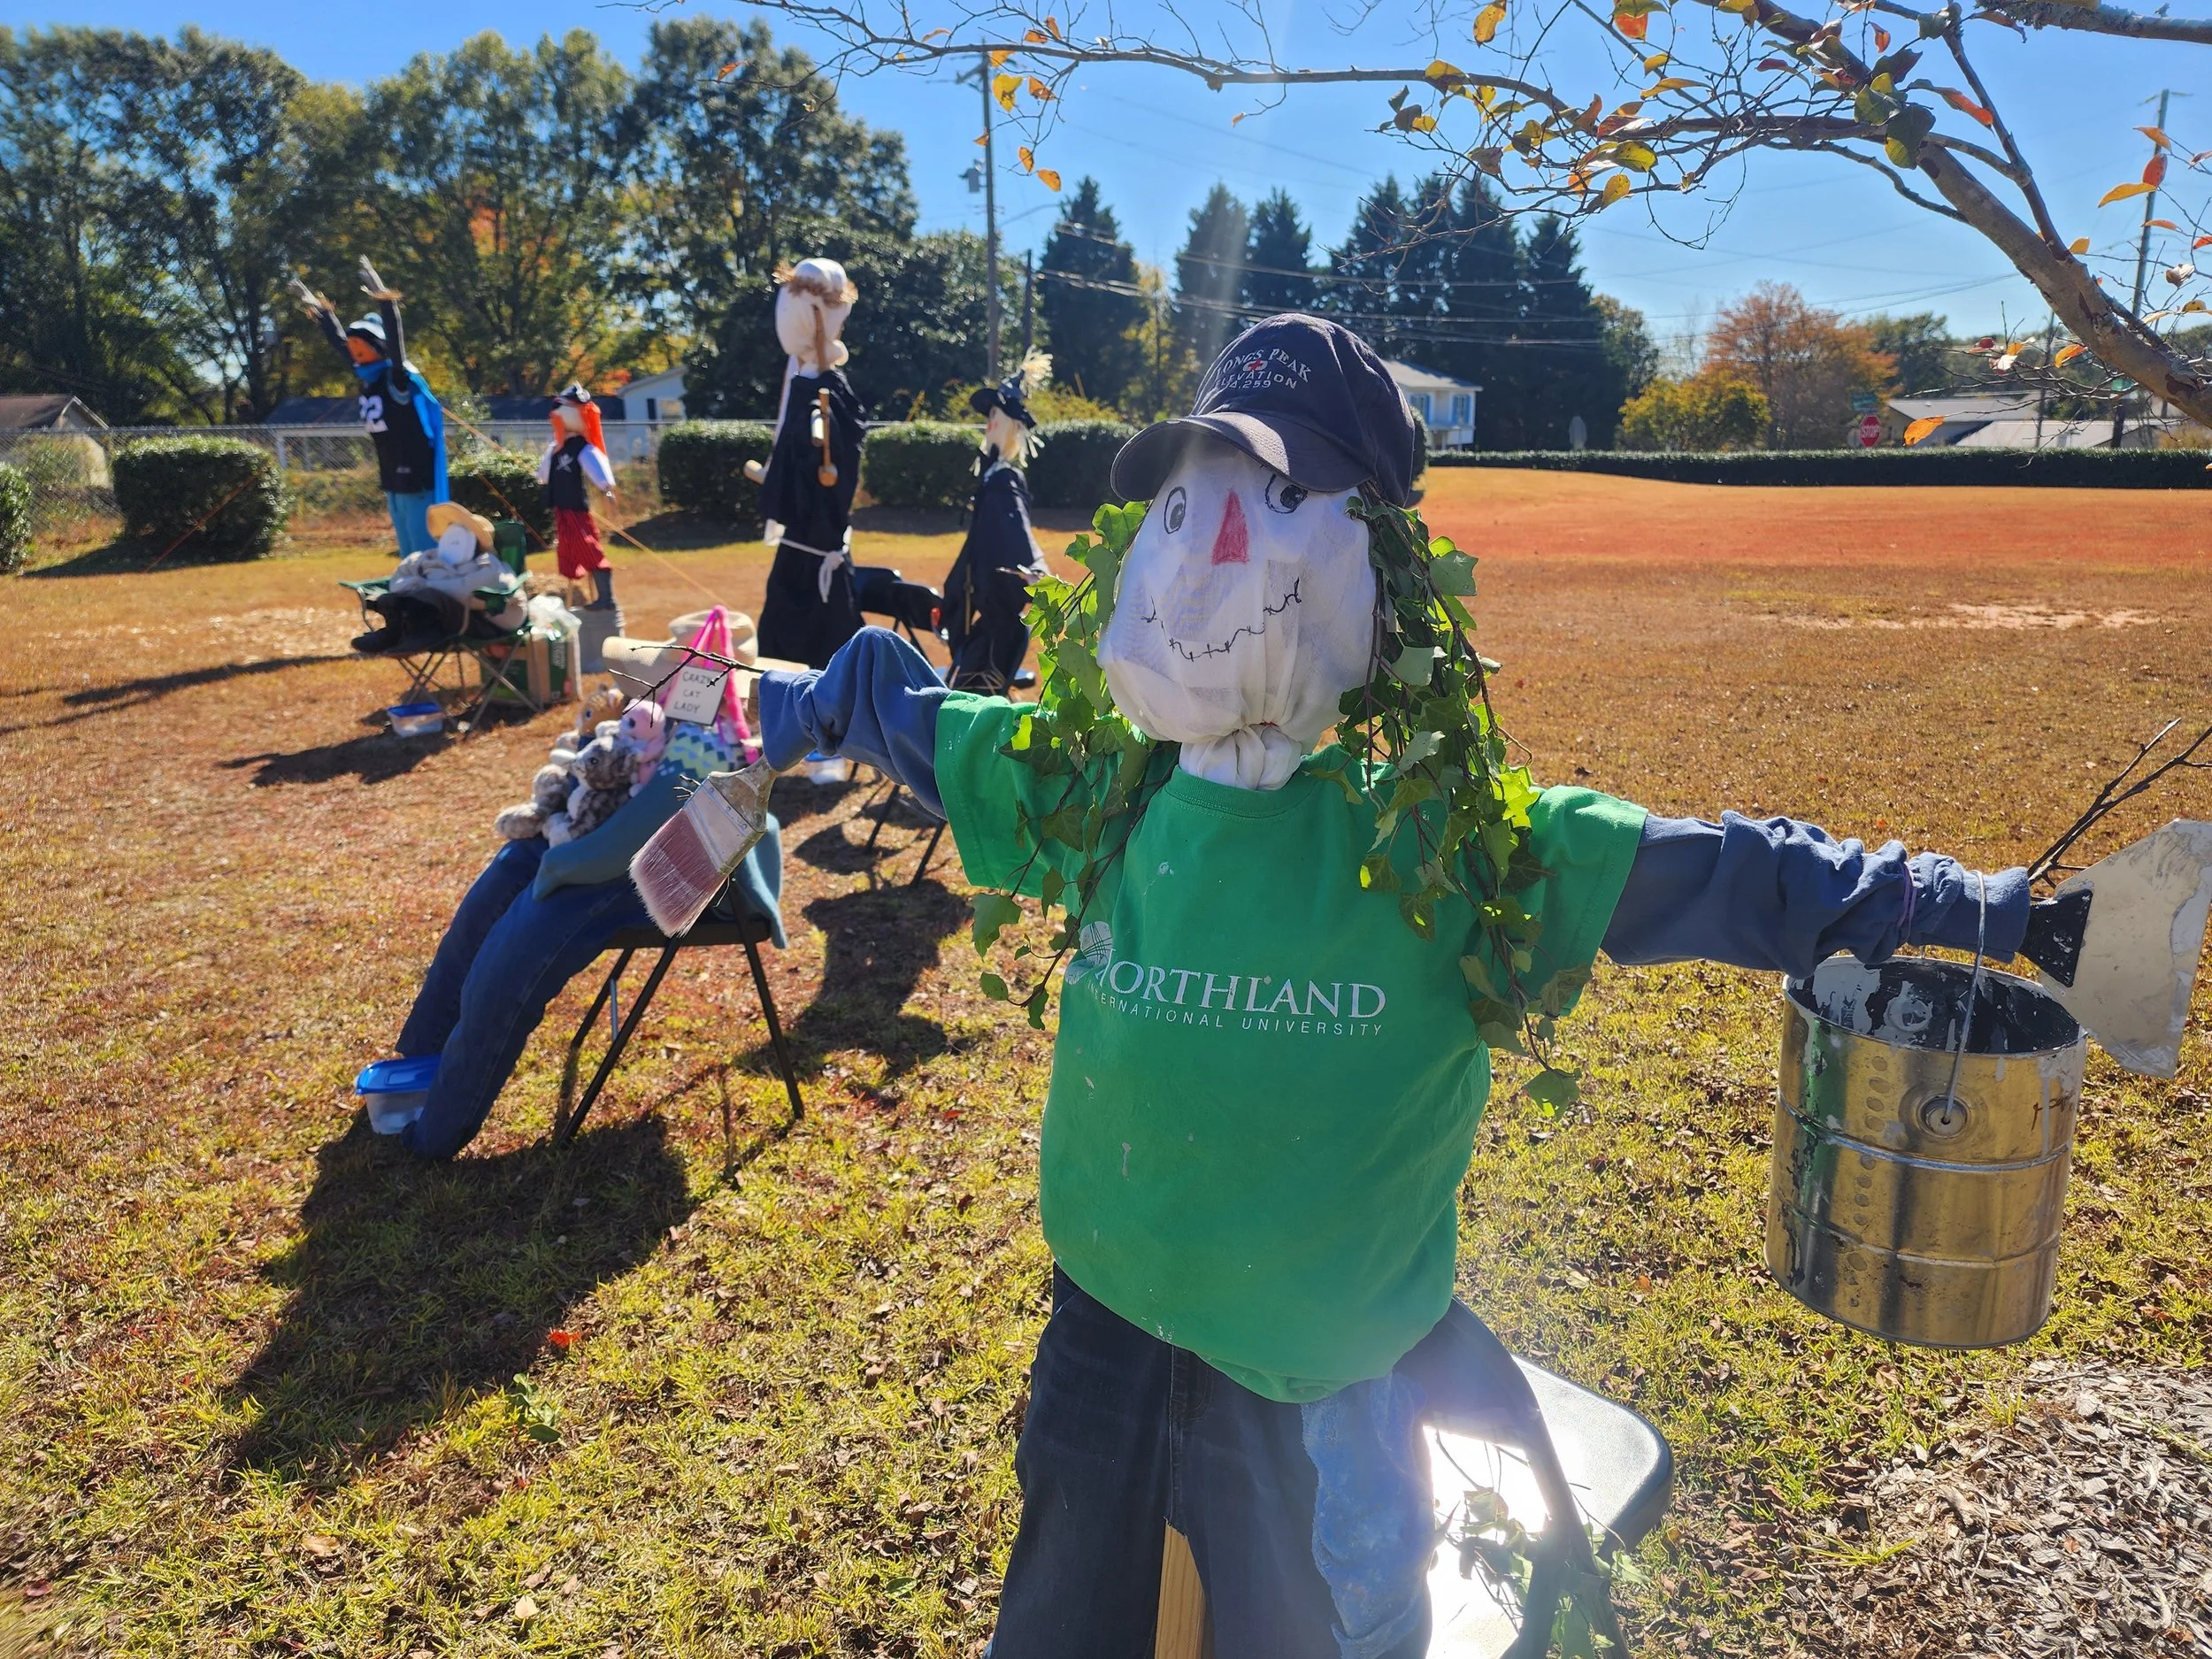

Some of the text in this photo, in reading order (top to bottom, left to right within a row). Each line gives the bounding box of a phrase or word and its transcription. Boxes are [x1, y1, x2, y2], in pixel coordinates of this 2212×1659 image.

[1268, 348, 1311, 383] PEAK
[1216, 370, 1298, 389] ELEVATION
[1861, 425, 1880, 439] STOP
[682, 688, 701, 699] CAT
[674, 701, 701, 714] LADY
[1087, 979, 1383, 1037] INTERNATIONAL UNIVERSITY
